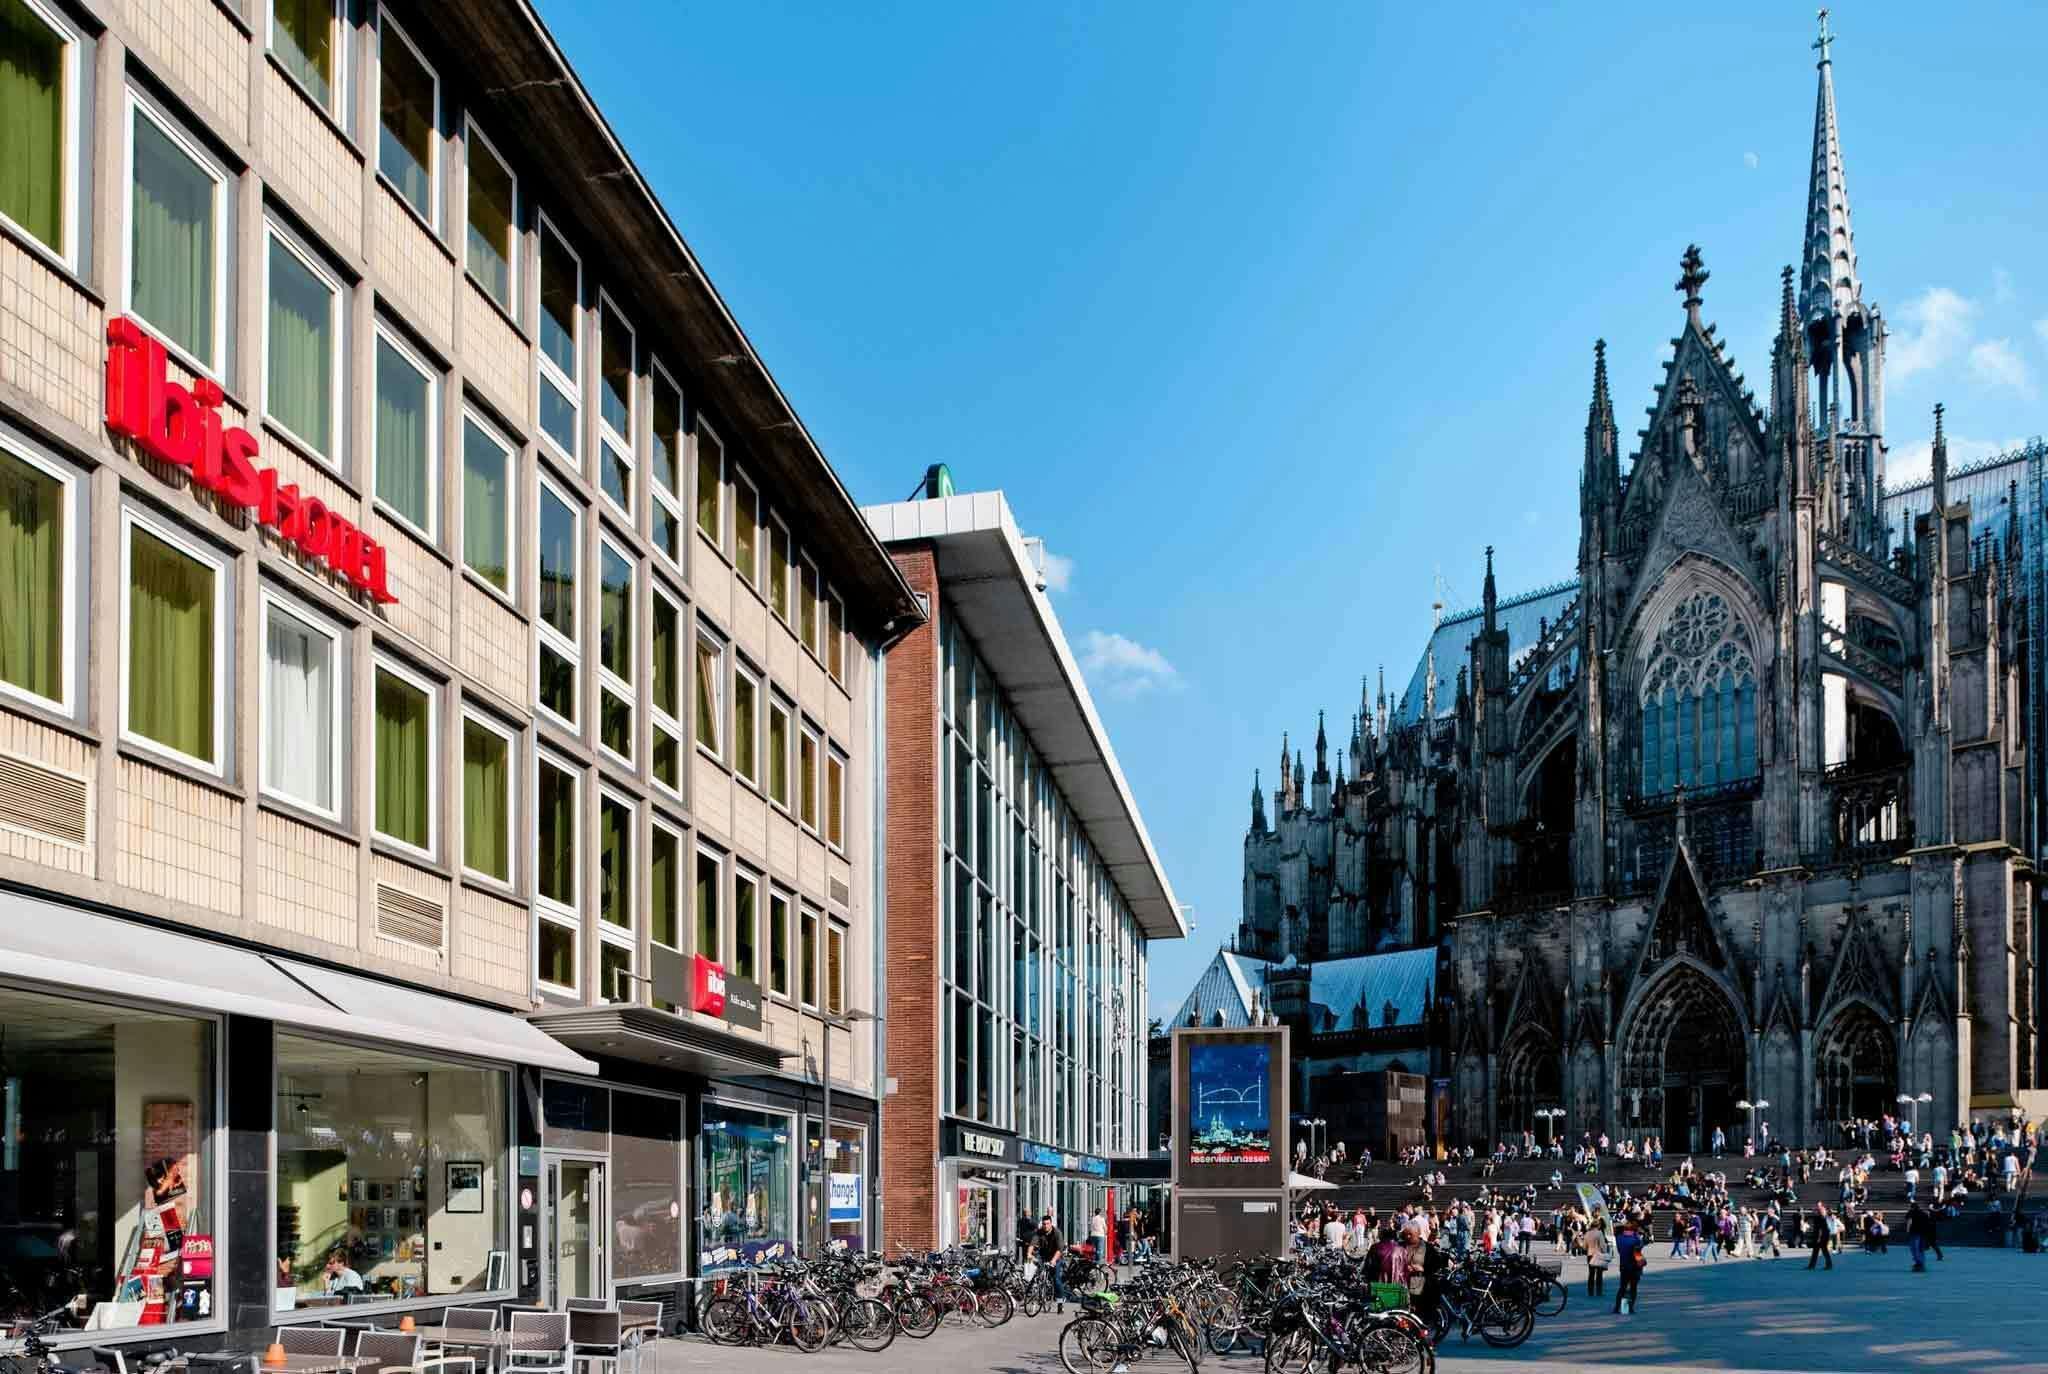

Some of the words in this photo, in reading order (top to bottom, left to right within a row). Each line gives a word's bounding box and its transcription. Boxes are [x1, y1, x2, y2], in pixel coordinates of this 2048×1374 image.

[106, 317, 263, 507] ibis
[258, 468, 399, 604] HOTEL
[707, 968, 726, 997] ibis
